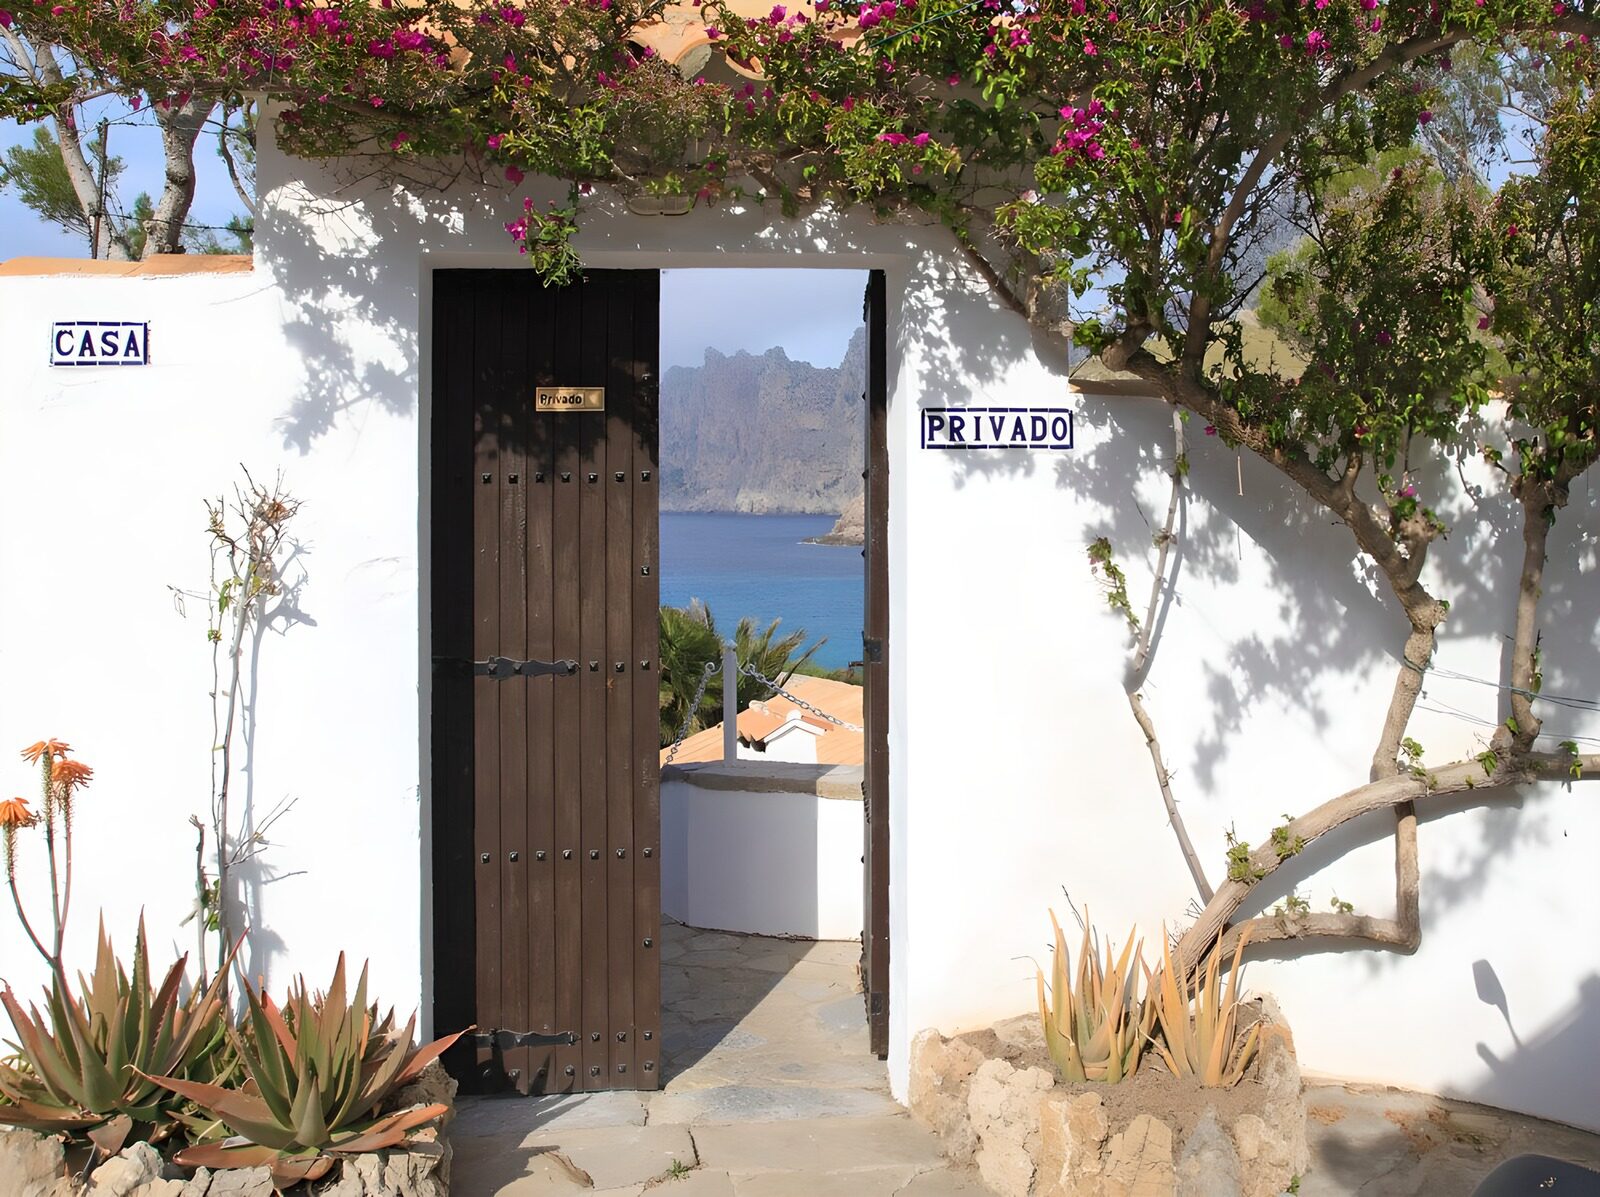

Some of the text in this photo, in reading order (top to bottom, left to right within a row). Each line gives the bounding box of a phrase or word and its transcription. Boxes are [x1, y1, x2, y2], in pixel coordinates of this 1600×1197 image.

[55, 329, 141, 357] CASA
[540, 393, 583, 405] Privado
[927, 415, 1068, 442] PRIVADO
